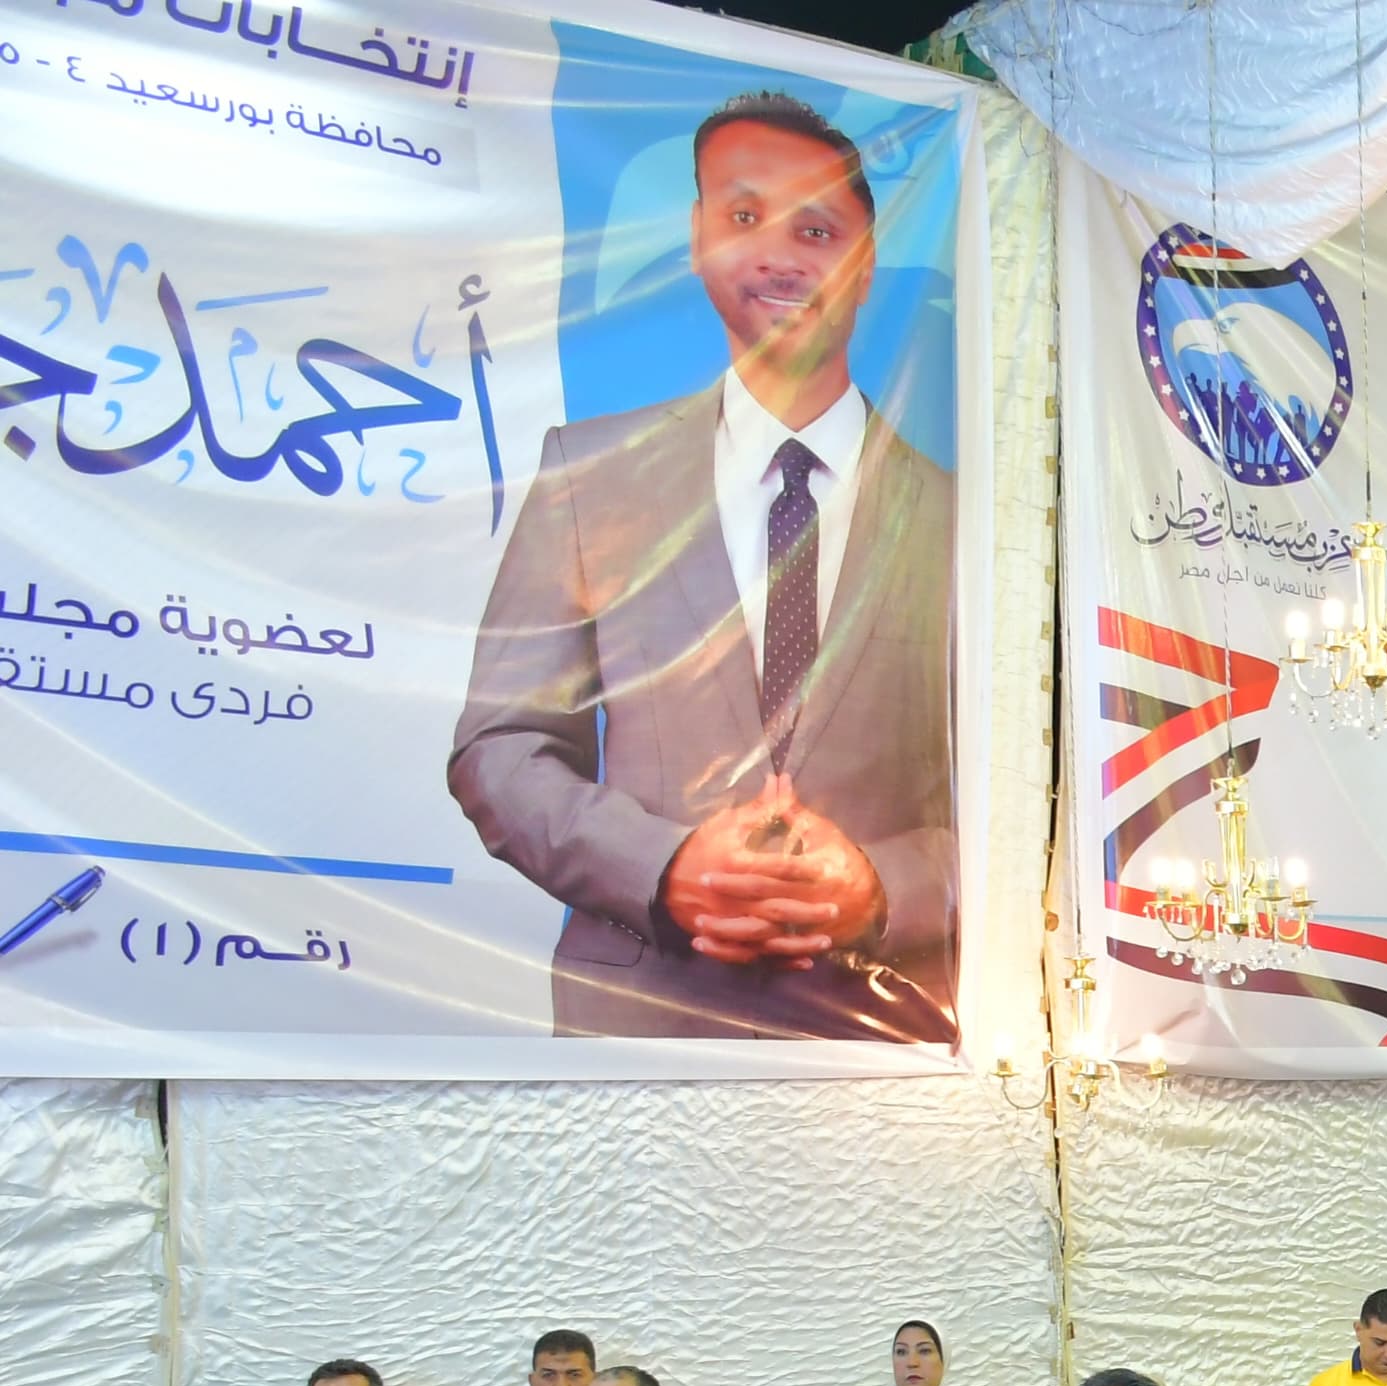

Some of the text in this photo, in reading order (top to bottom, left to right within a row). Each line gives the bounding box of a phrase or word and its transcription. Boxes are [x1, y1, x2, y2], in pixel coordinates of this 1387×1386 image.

[66, 55, 86, 82] ٤
[106, 71, 274, 135] بورسعيد
[286, 103, 443, 166] محافظة
[58, 273, 507, 538] أحمد
[1179, 562, 1211, 580] مصر
[1253, 571, 1270, 587] من
[0, 583, 374, 659] لعضوية مجل
[215, 929, 351, 970] رقم
